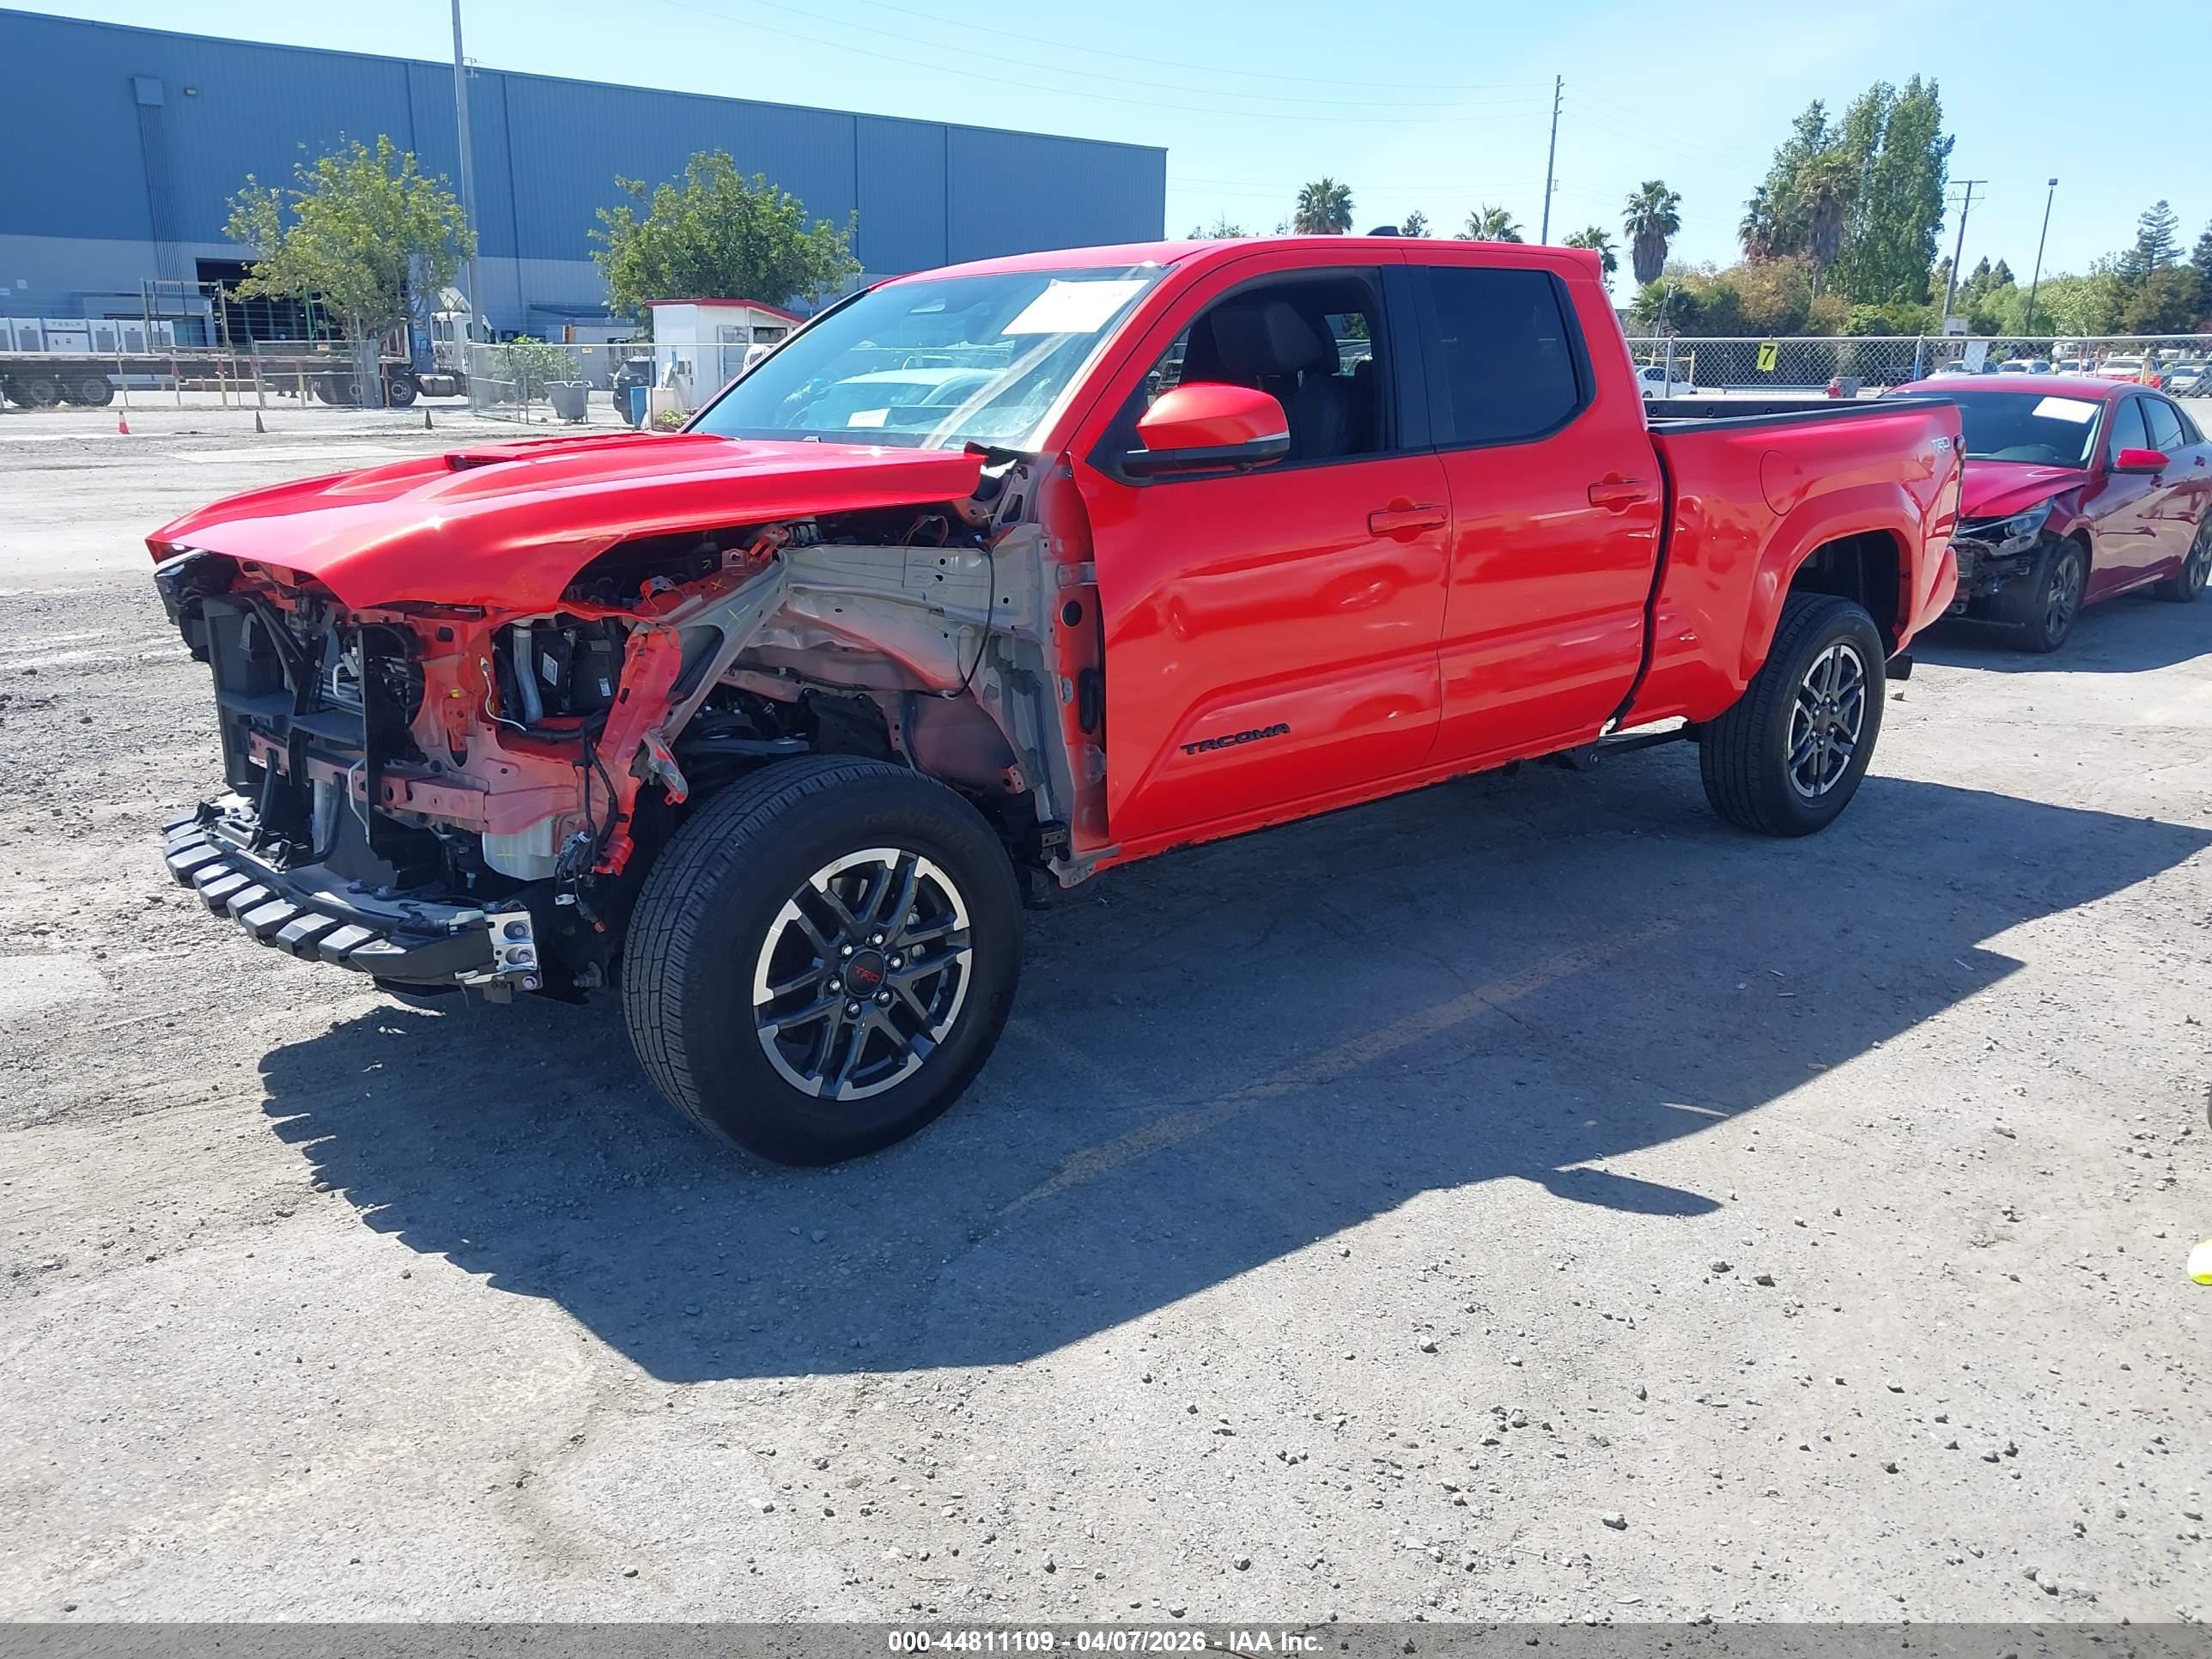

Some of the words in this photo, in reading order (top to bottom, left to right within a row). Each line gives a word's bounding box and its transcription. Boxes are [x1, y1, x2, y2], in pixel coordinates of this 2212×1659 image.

[1762, 345, 1776, 366] 7
[1931, 436, 1950, 453] TRD
[1179, 722, 1291, 756] TACOMA
[854, 965, 879, 982] TRD
